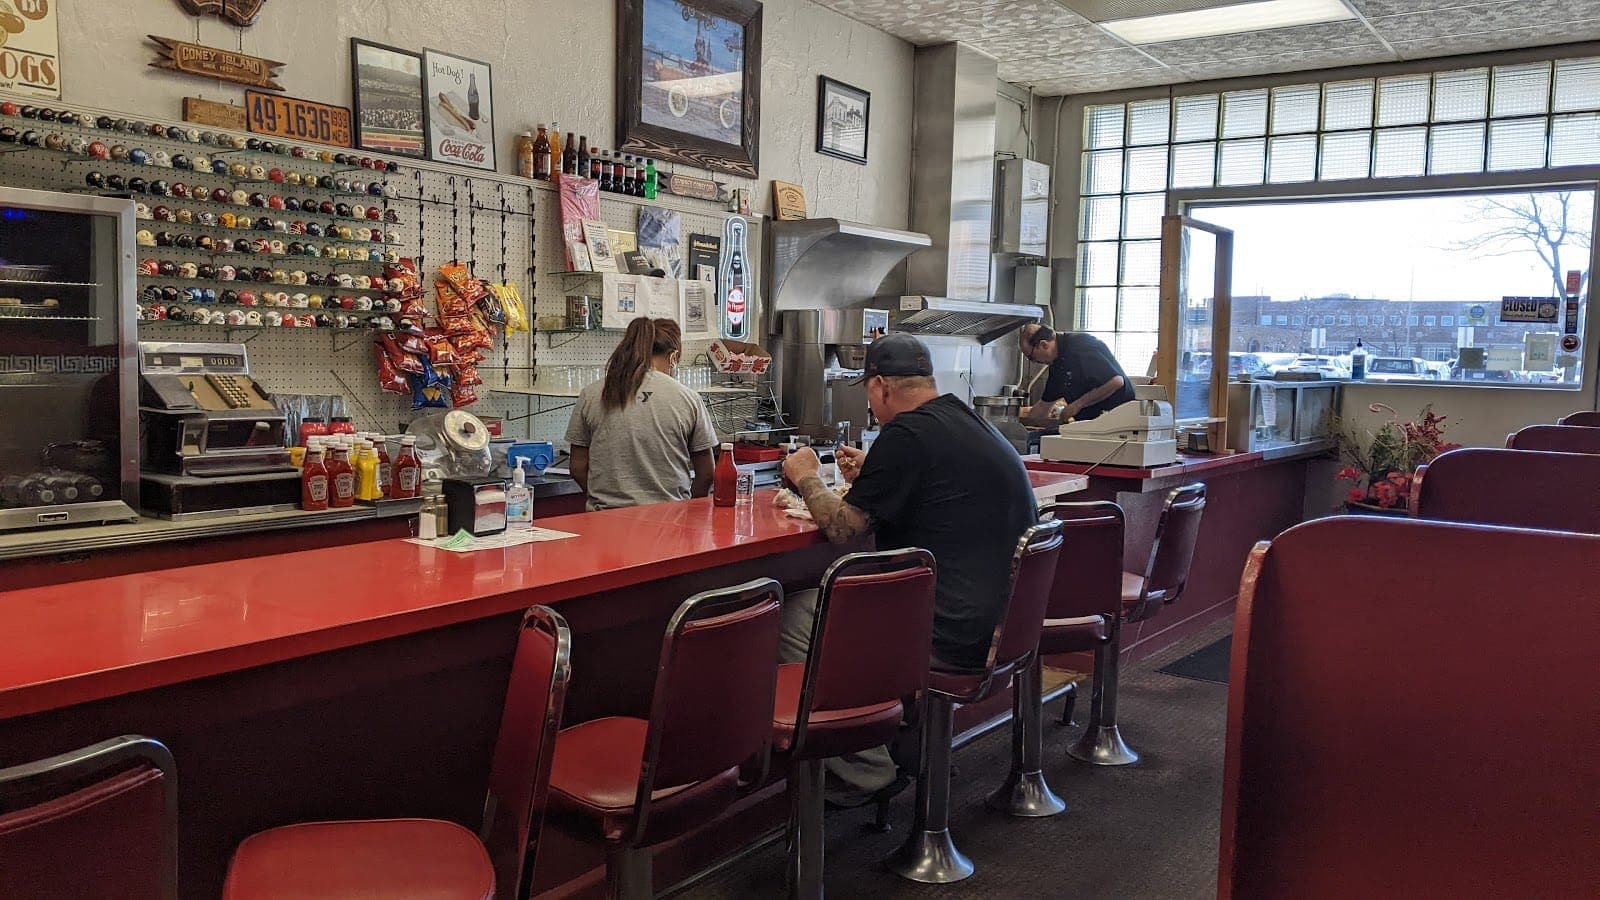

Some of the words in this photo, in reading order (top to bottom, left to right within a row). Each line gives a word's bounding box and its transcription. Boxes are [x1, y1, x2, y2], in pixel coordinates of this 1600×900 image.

[182, 47, 216, 61] CONEY
[223, 55, 260, 74] ISLAND
[432, 61, 446, 77] Hot
[447, 65, 464, 85] Dog!
[332, 129, 348, 144] NEB
[1503, 299, 1538, 312] CLOSED
